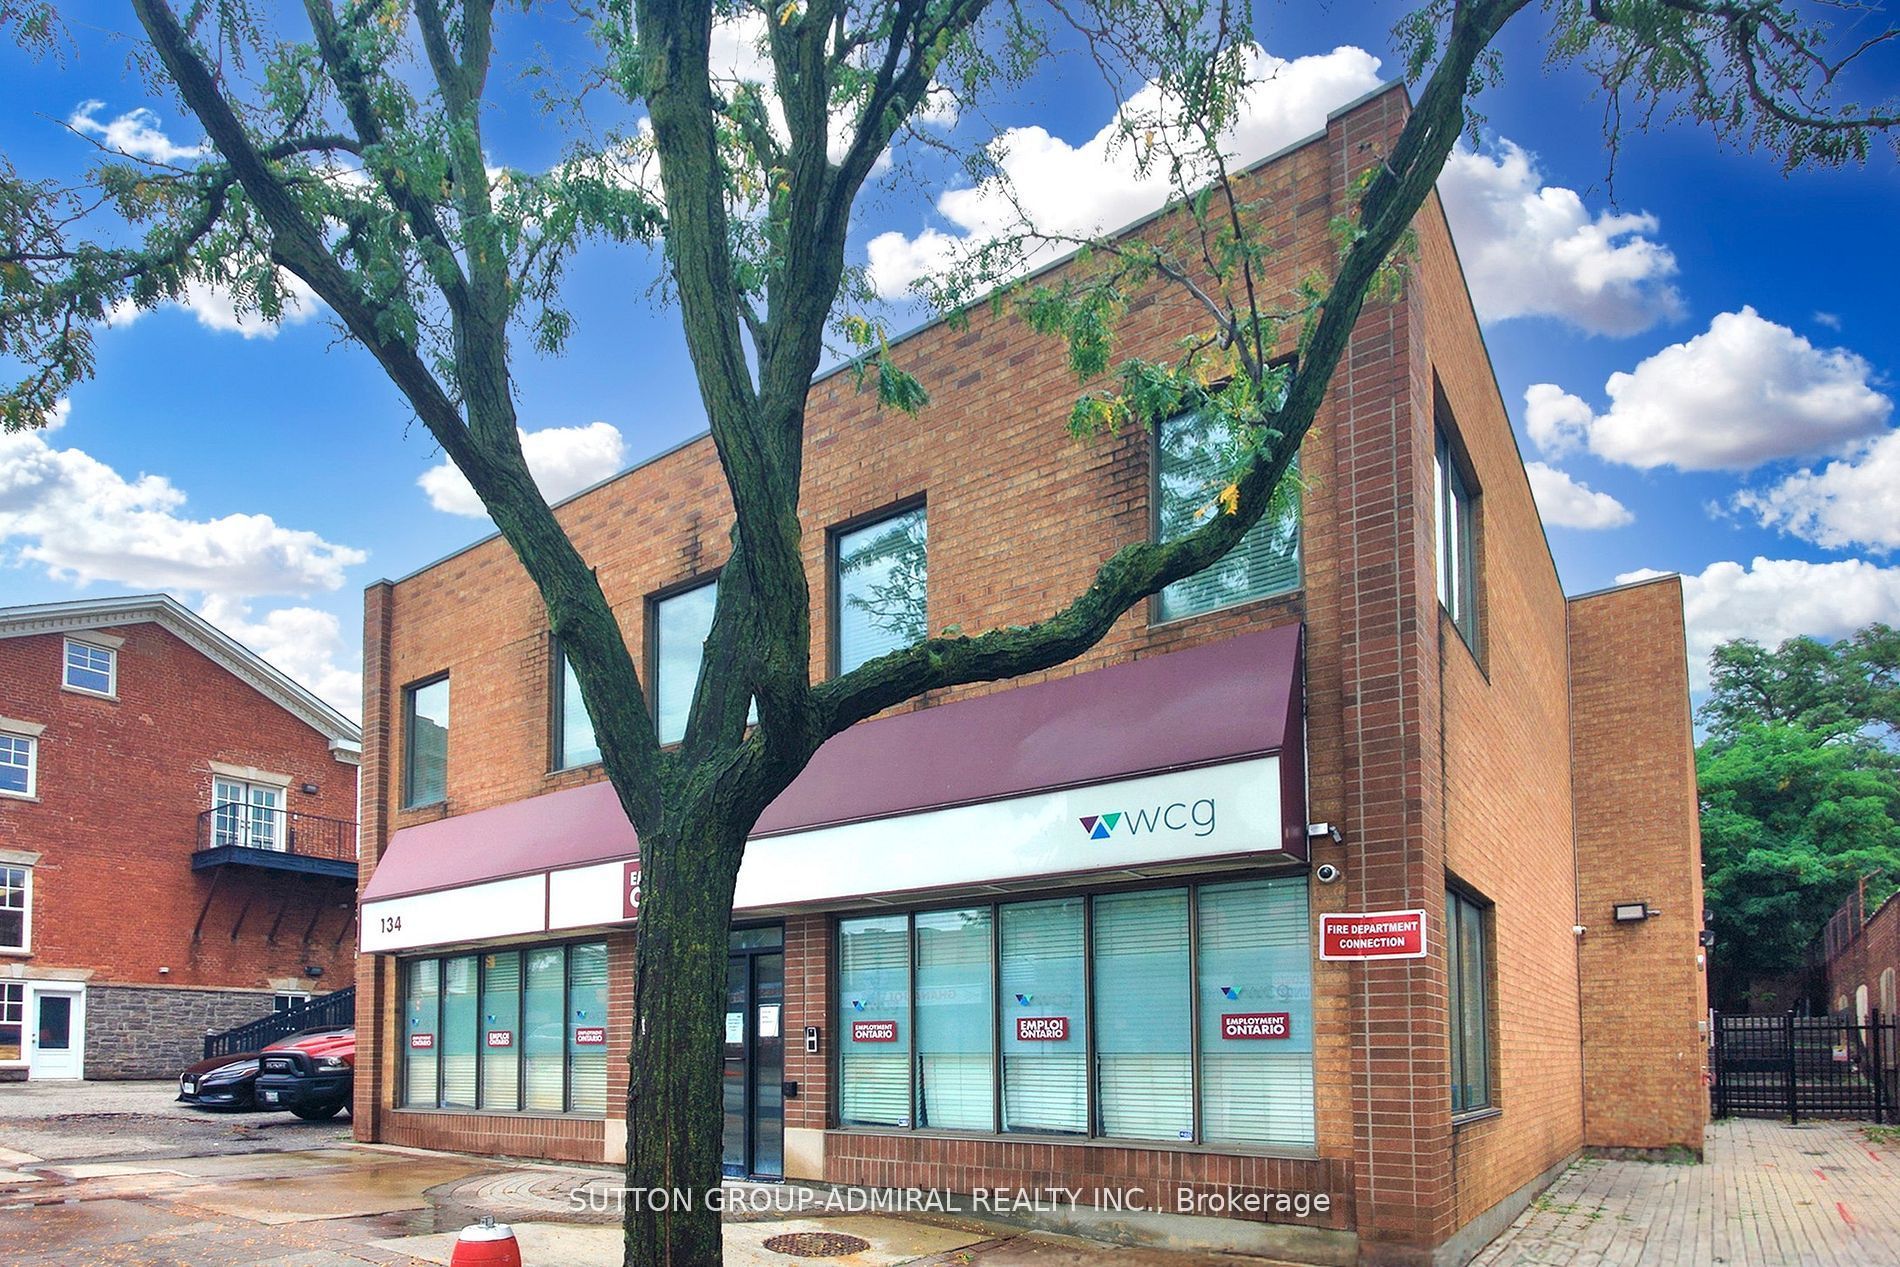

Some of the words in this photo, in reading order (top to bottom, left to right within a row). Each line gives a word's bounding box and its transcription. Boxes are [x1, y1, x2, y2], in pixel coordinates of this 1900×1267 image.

[1124, 798, 1215, 836] wcg
[380, 916, 402, 933] 134
[1327, 924, 1349, 934] FIRE
[1351, 921, 1418, 934] DEPARTMENT
[1339, 936, 1406, 949] CONNECTION
[1020, 1019, 1063, 1030] EMPLOI
[1226, 1016, 1285, 1025] EMPLOYMENT
[855, 1030, 893, 1039] ONTARIO
[1020, 1029, 1063, 1039] ONTARIO
[1226, 1024, 1285, 1036] ONTARIO
